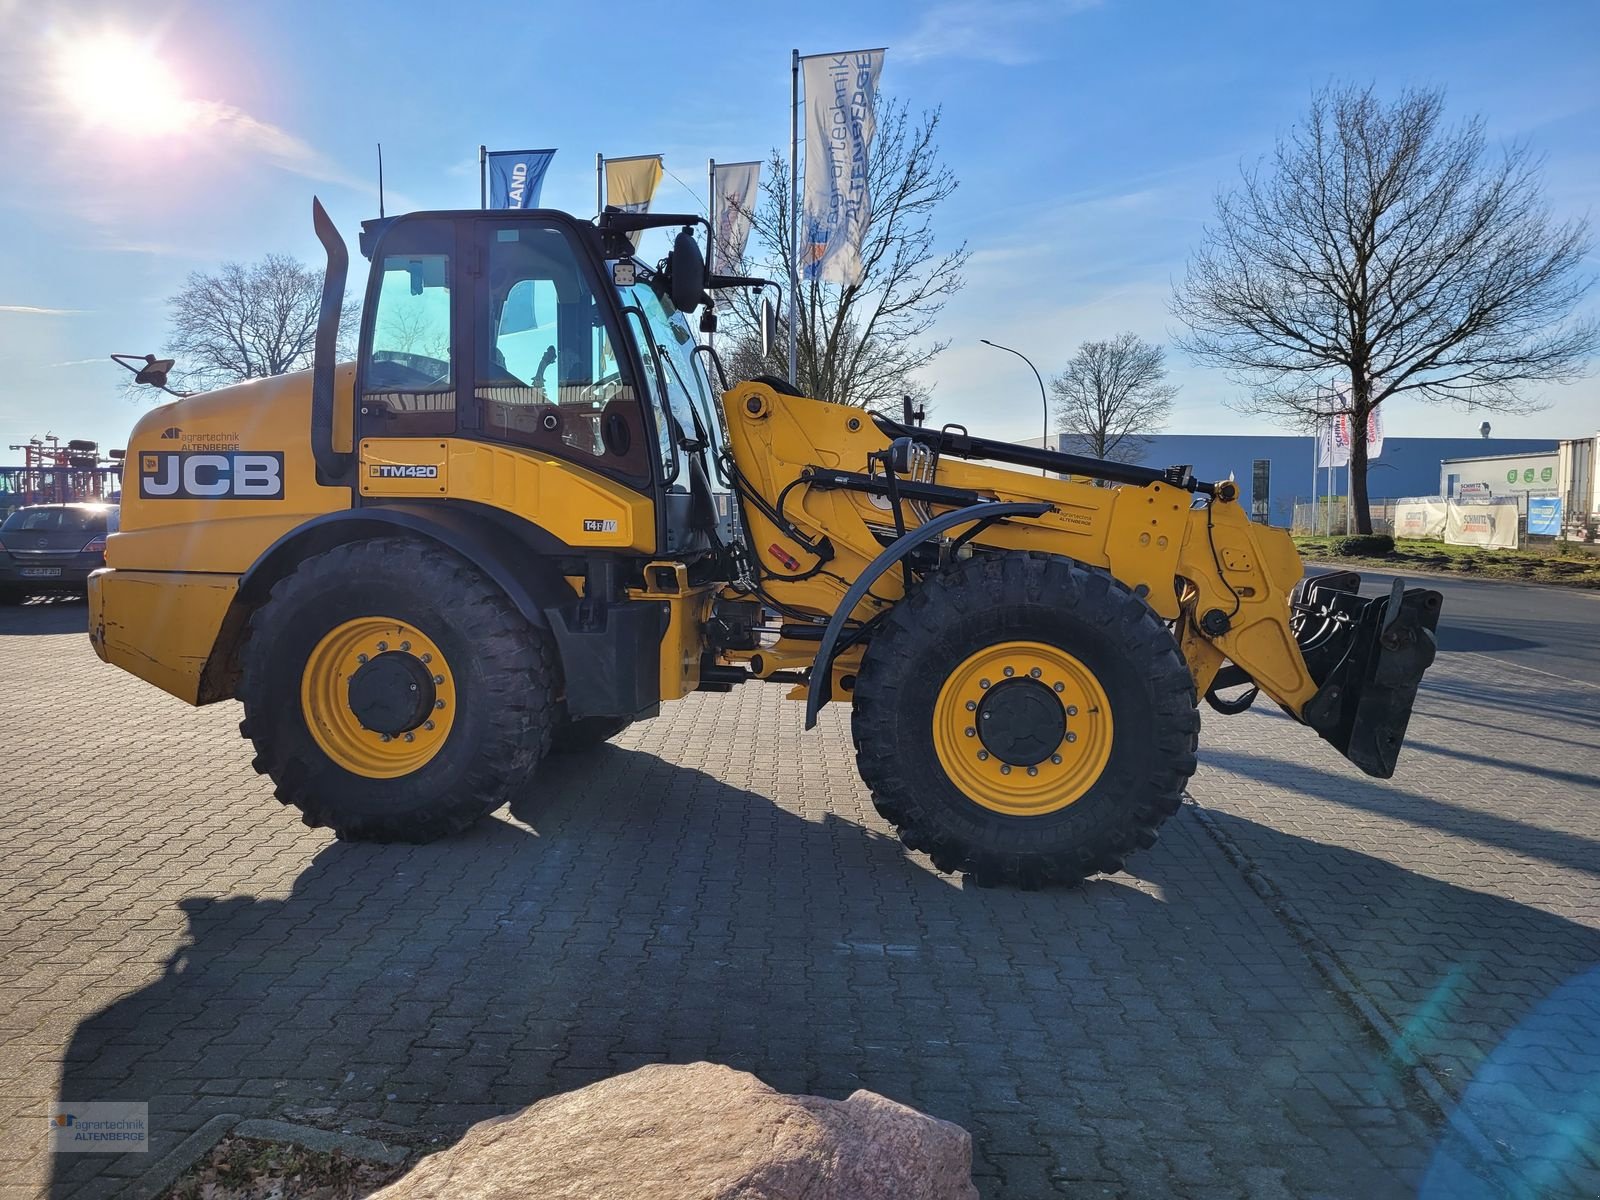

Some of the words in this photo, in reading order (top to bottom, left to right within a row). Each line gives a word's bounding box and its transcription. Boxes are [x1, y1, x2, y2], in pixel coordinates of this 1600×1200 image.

[826, 55, 849, 225] agrartechnik
[181, 432, 240, 443] agrartechnik
[181, 443, 240, 451] ALTENBERGE
[143, 455, 281, 496] JCB
[380, 466, 437, 478] TM420
